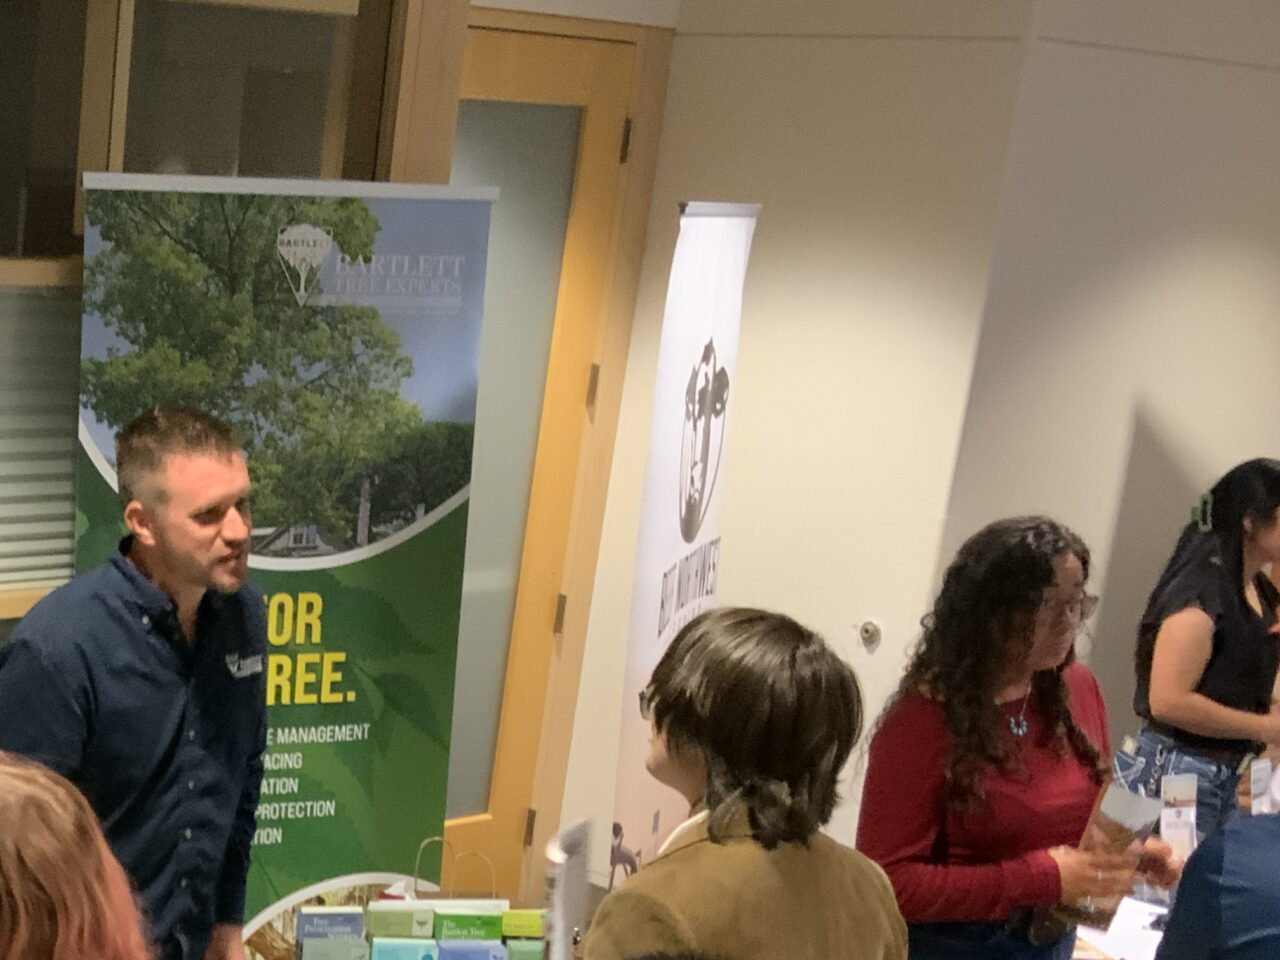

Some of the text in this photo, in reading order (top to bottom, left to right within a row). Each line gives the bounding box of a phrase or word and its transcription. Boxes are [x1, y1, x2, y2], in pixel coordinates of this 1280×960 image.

[335, 254, 466, 276] BARTLETT
[263, 592, 323, 646] OR
[266, 652, 356, 706] REE.
[276, 723, 370, 744] MANAGEMENT
[261, 752, 303, 770] ACING
[260, 778, 299, 795] ATION
